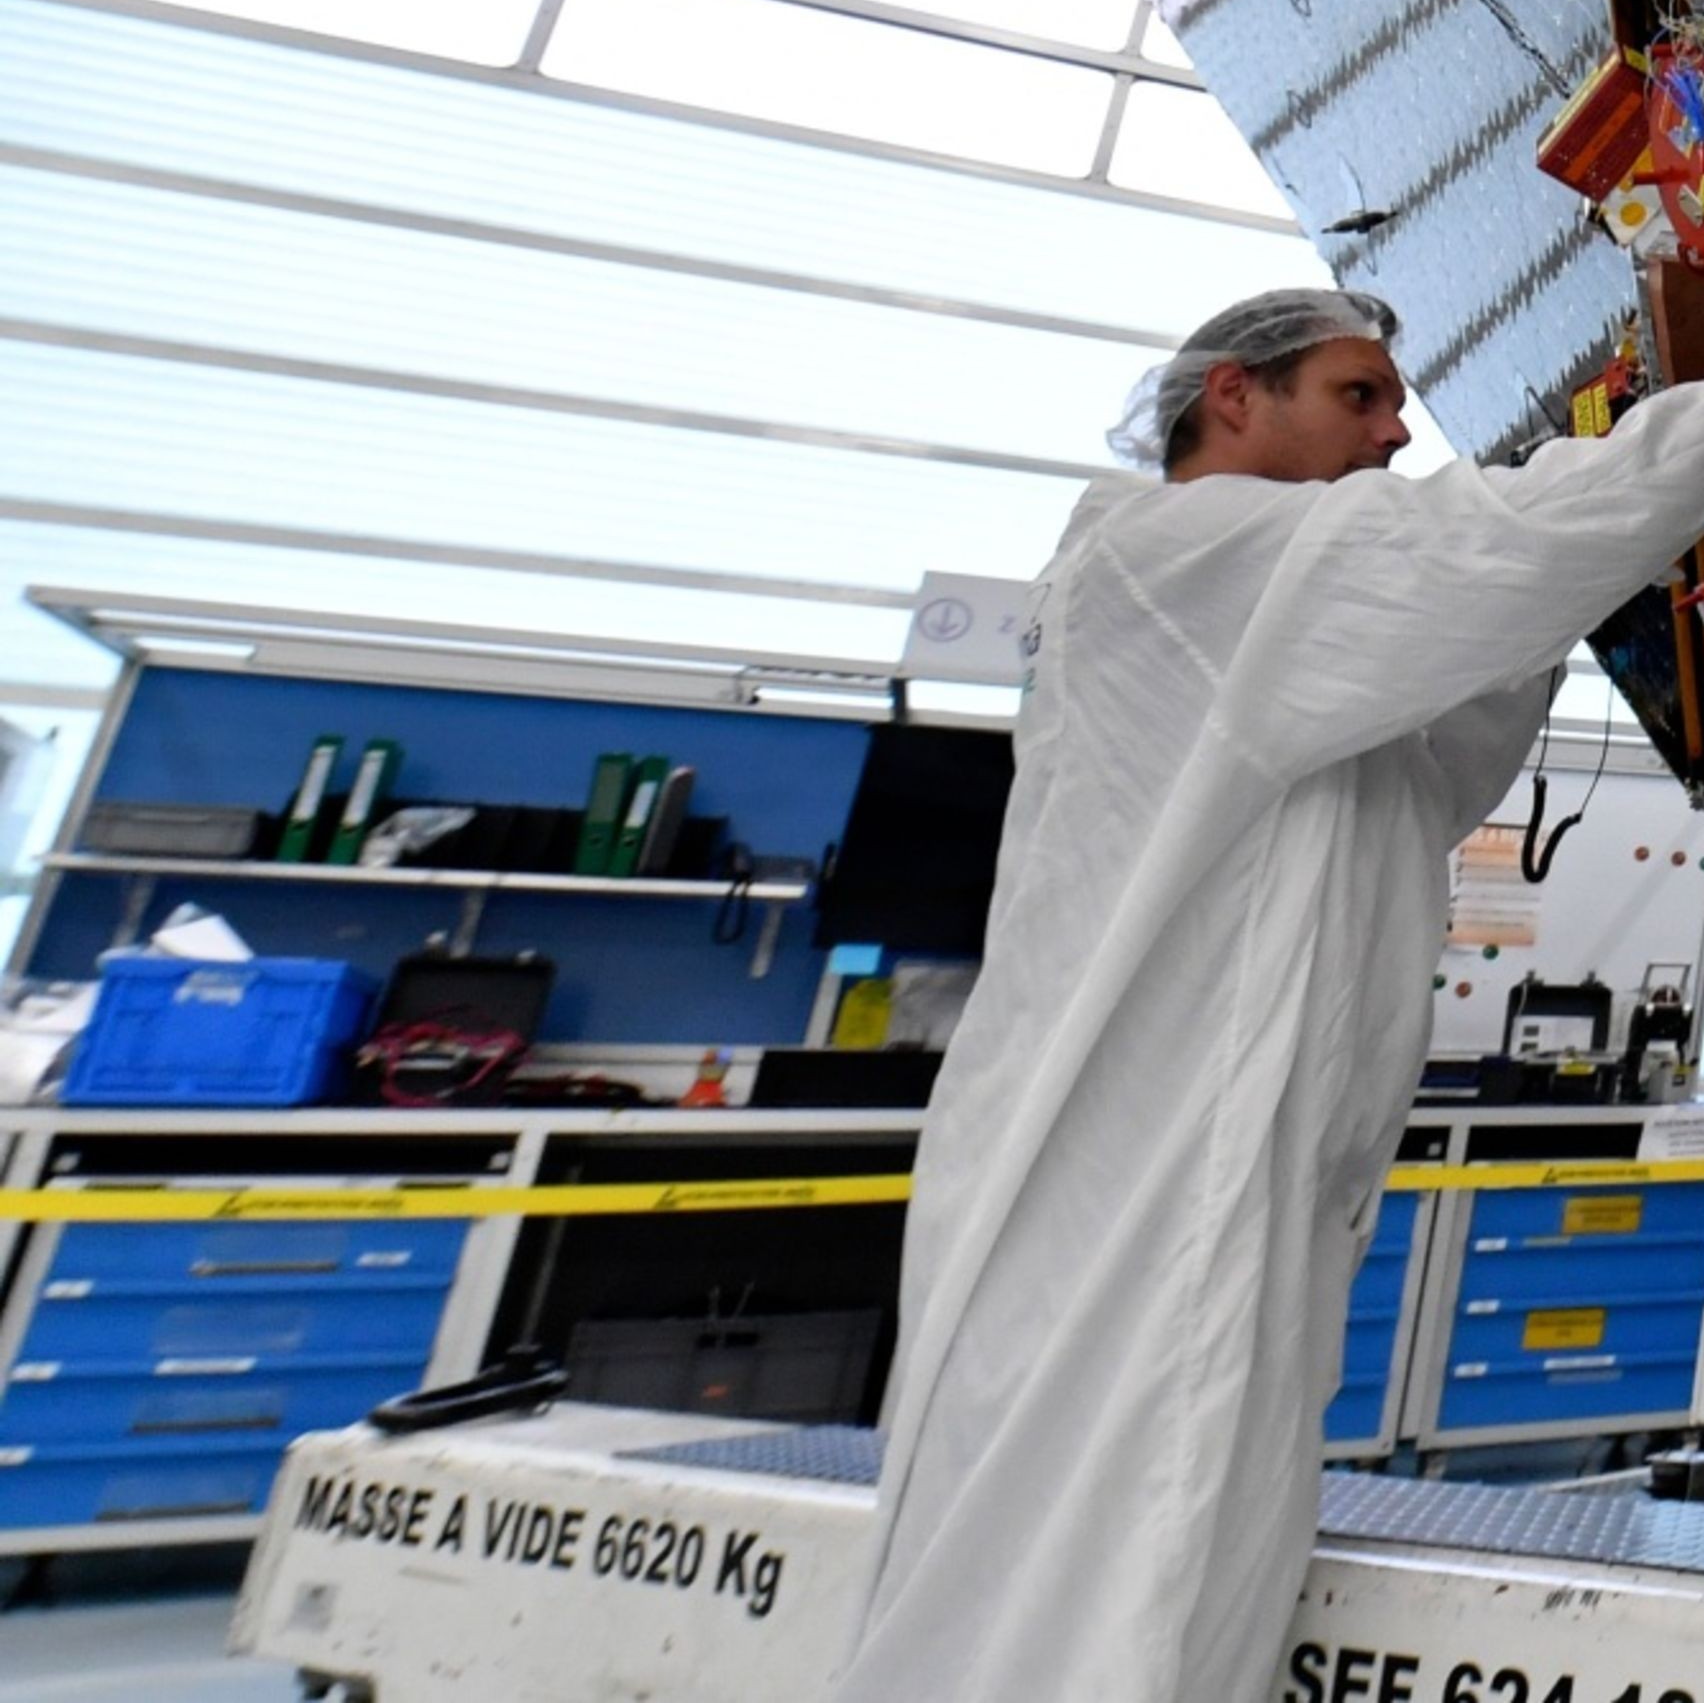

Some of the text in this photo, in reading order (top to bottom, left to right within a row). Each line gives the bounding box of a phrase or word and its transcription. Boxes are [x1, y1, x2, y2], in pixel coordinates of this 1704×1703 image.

[296, 1475, 787, 1618] MASSE A VIDE 6620 Kg
